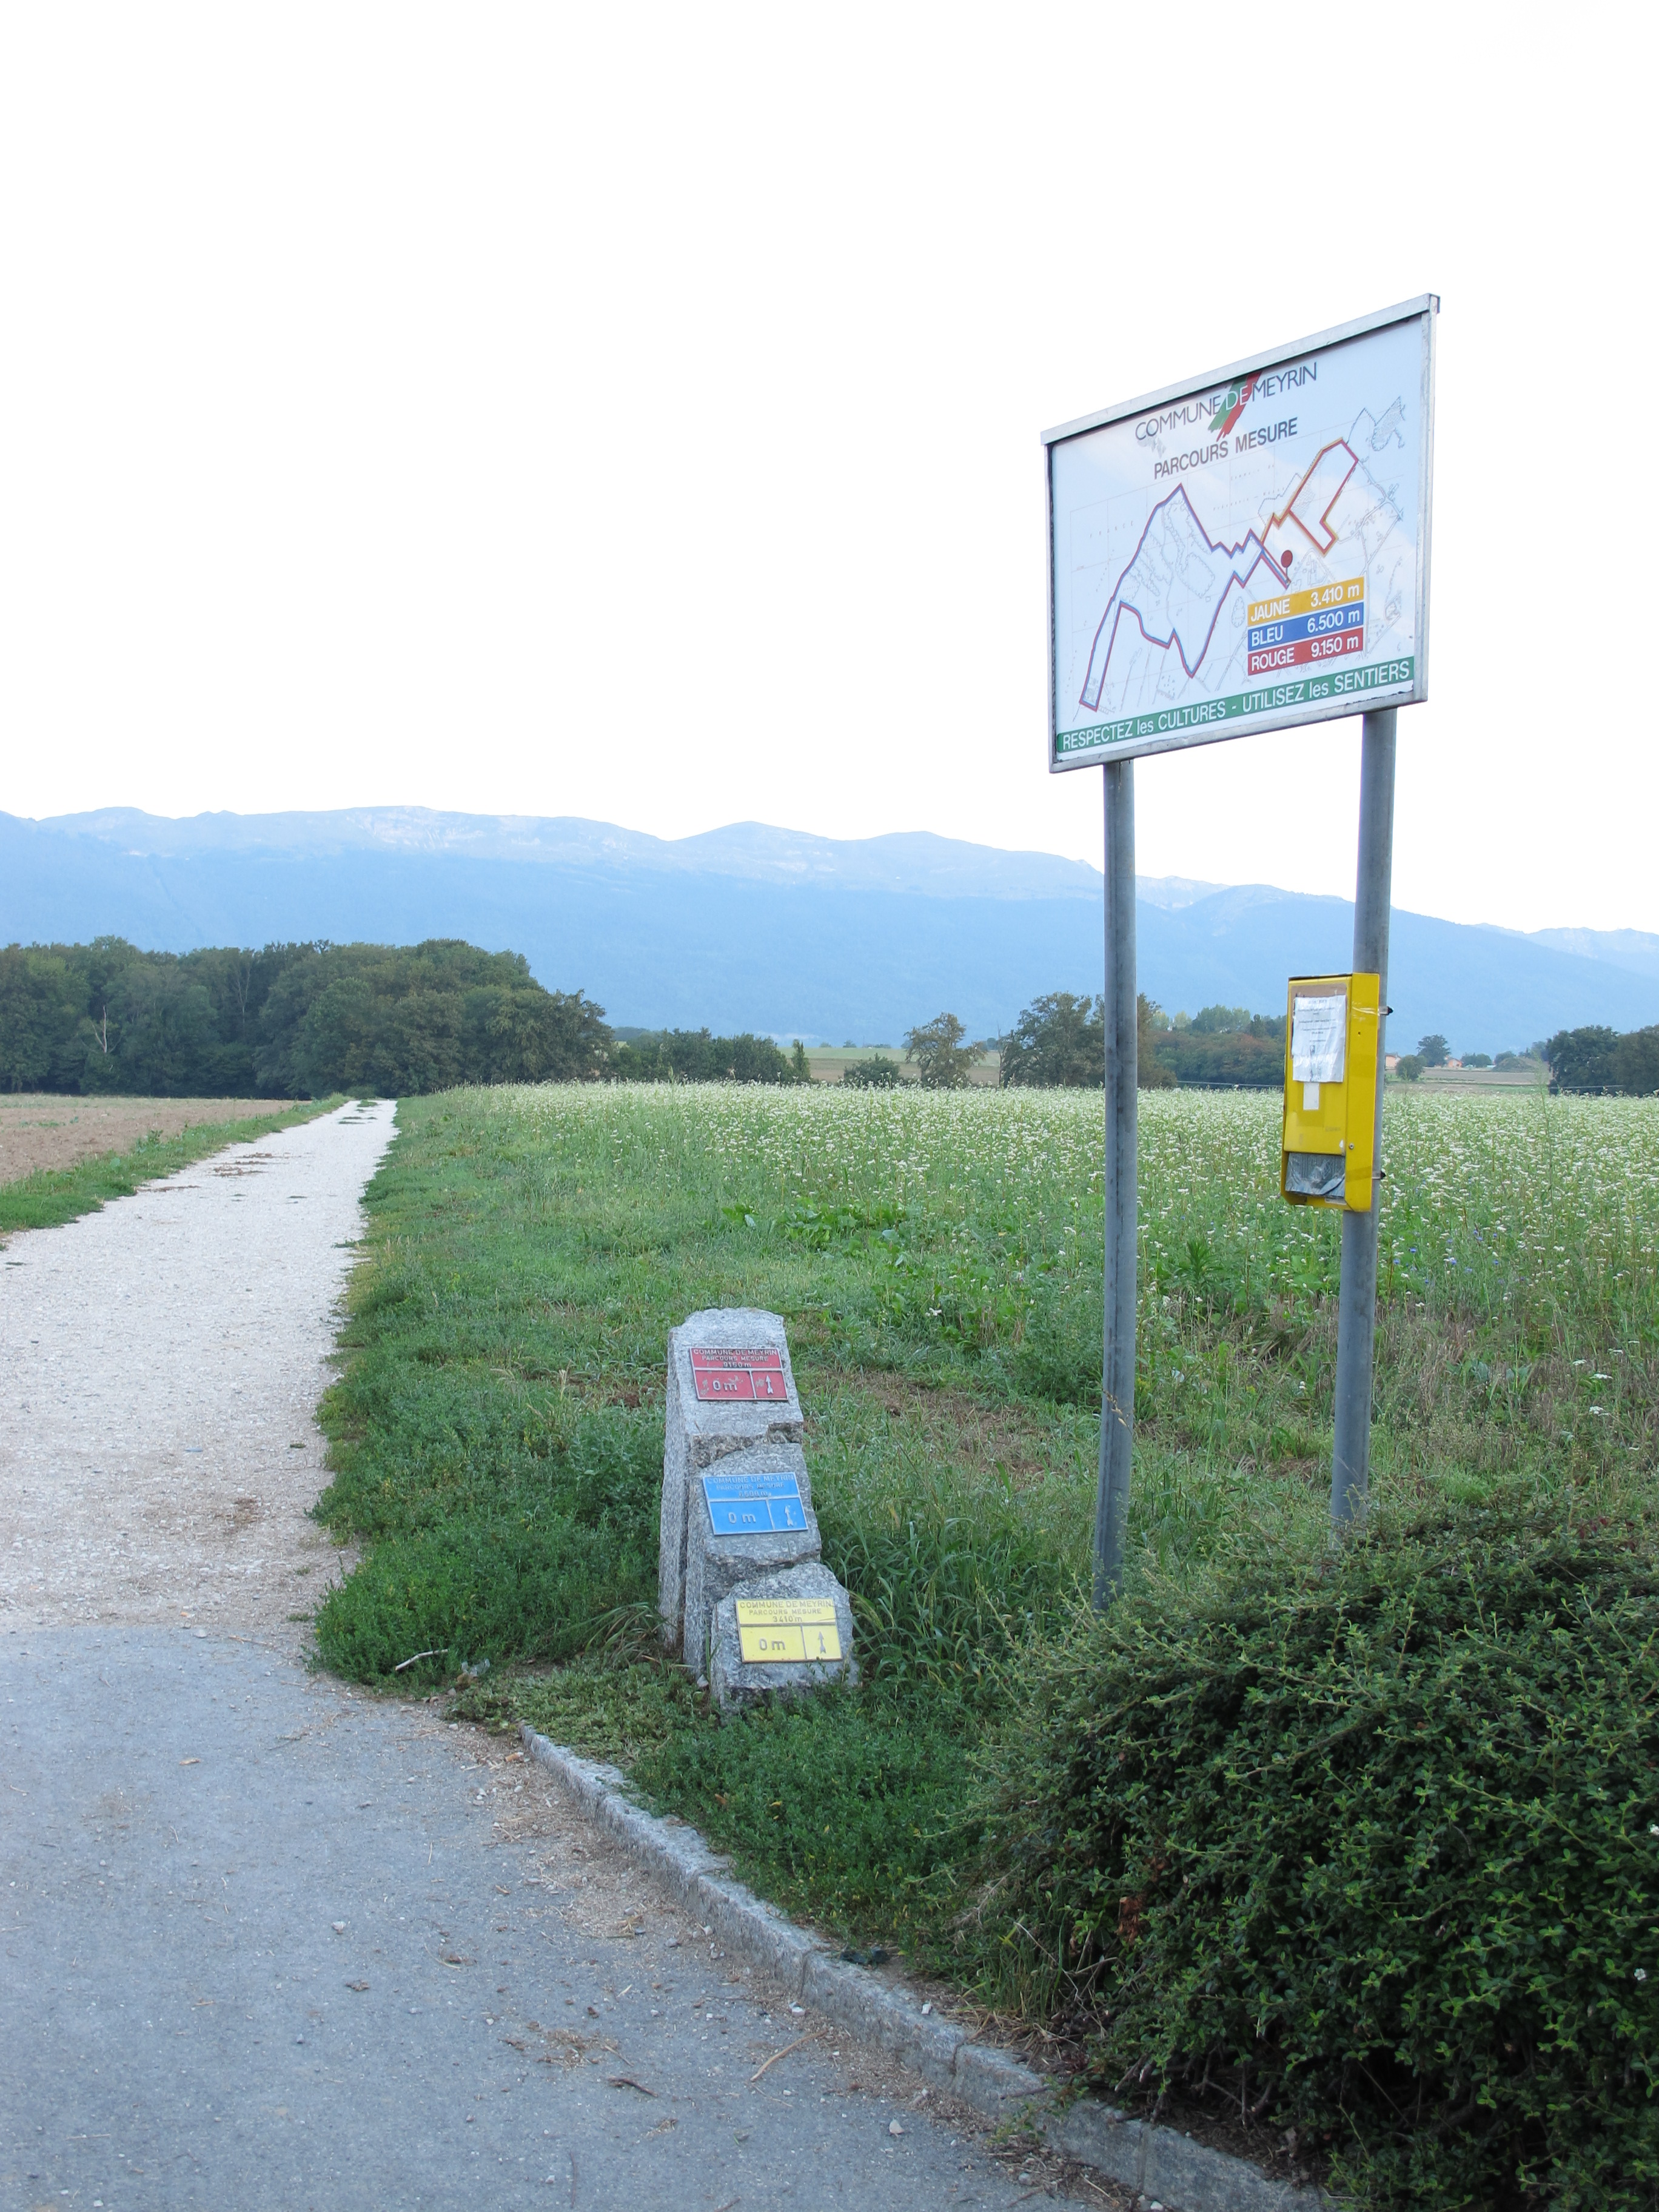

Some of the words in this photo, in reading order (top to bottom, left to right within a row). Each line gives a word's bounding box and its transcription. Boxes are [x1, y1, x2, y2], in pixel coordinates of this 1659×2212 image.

[1135, 395, 1221, 440] COMMUNE
[1225, 384, 1248, 411] DE
[1252, 362, 1317, 402] MEYRIN
[1154, 441, 1228, 480] PARCOURS
[1235, 417, 1298, 454] MESURE
[1250, 598, 1290, 622] JAUNE
[1310, 586, 1343, 607] 3.410
[1347, 585, 1359, 598] m
[1251, 625, 1283, 647] BLEU
[1307, 611, 1344, 633] 6.500
[1348, 609, 1359, 623] m
[1251, 647, 1295, 671] ROUGE
[1311, 637, 1342, 657] 9.150
[1347, 635, 1359, 649] m
[1062, 720, 1133, 750] RESPECTEZ
[1136, 719, 1154, 735] les
[1158, 701, 1225, 731] CULTURES
[1242, 683, 1304, 712] UTILISEZ
[1309, 681, 1329, 698] les
[1334, 661, 1409, 693] SENTIERS
[723, 1382, 737, 1392] m
[742, 1513, 756, 1523] m
[771, 1640, 786, 1651] m
